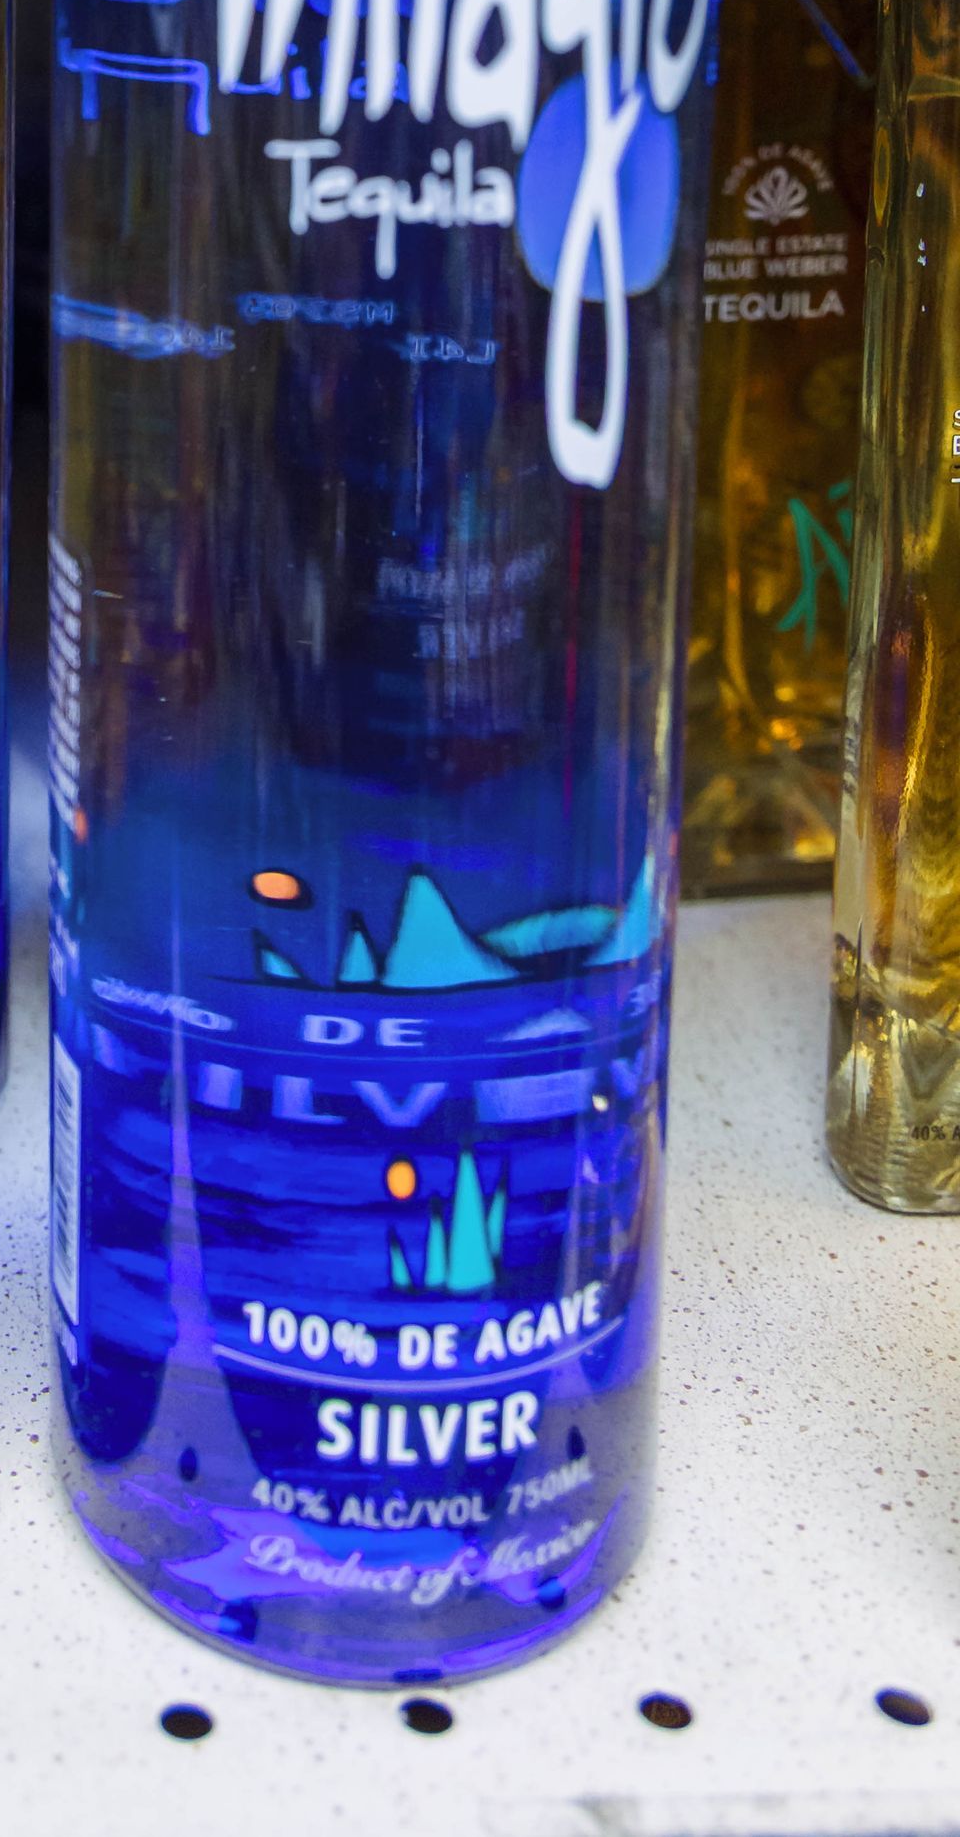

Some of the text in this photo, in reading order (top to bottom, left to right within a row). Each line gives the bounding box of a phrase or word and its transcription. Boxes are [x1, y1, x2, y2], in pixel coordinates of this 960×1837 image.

[263, 137, 516, 281] Tequila
[703, 289, 845, 324] TEQUILA
[242, 1280, 604, 1370] 100% DE AGAVE
[315, 1390, 539, 1467] SILVER
[250, 1455, 595, 1531] 40% ALC/VOL 750ML
[244, 1535, 411, 1592] Product
[409, 1546, 480, 1606] of
